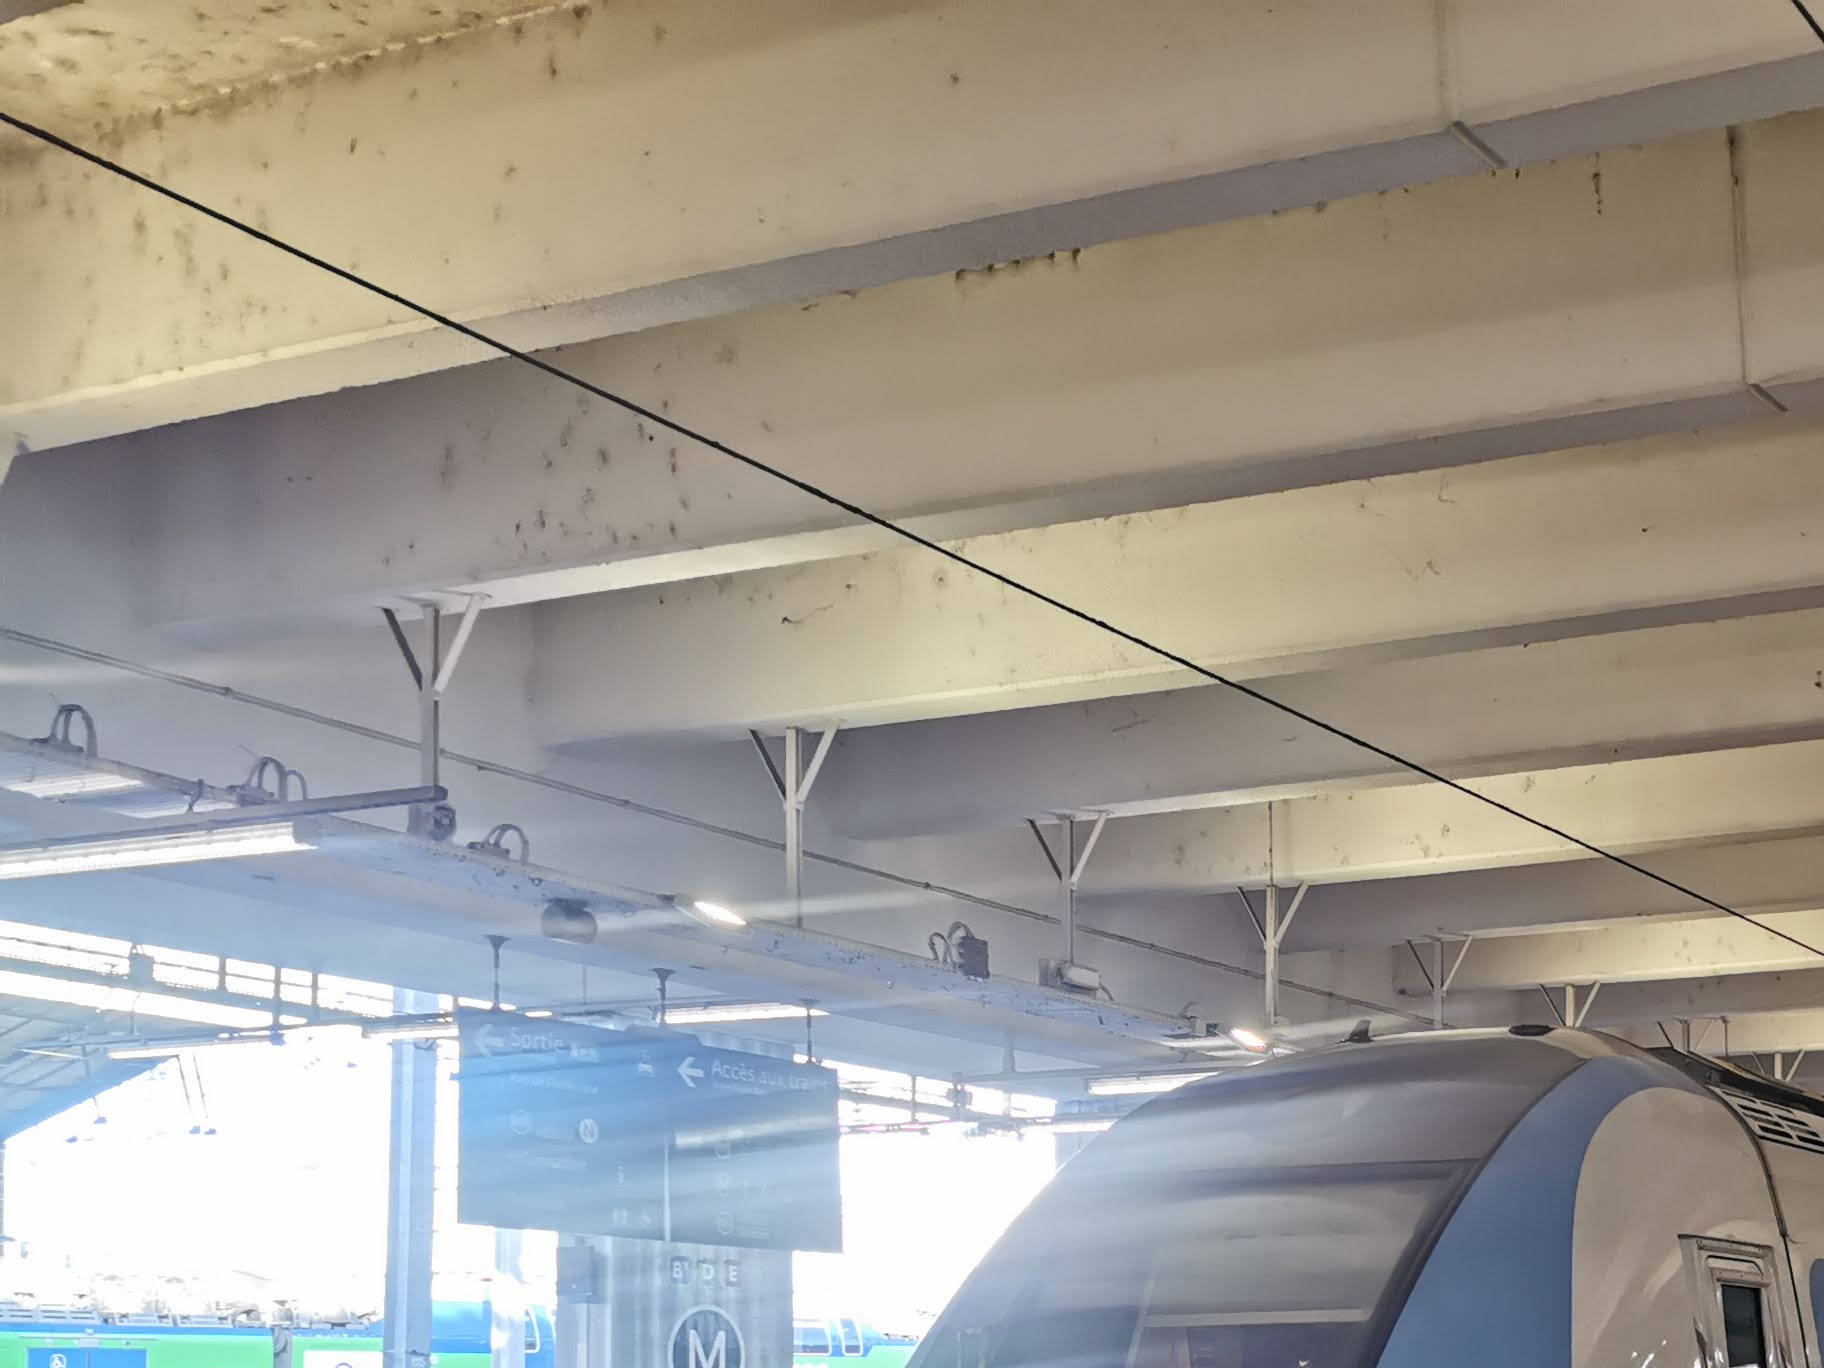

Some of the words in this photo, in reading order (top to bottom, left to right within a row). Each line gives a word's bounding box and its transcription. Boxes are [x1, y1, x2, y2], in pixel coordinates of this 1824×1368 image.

[510, 1027, 565, 1053] Sortie
[711, 1059, 755, 1082] Accès
[758, 1069, 786, 1088] aux
[702, 1263, 715, 1281] D
[728, 1265, 739, 1282] E
